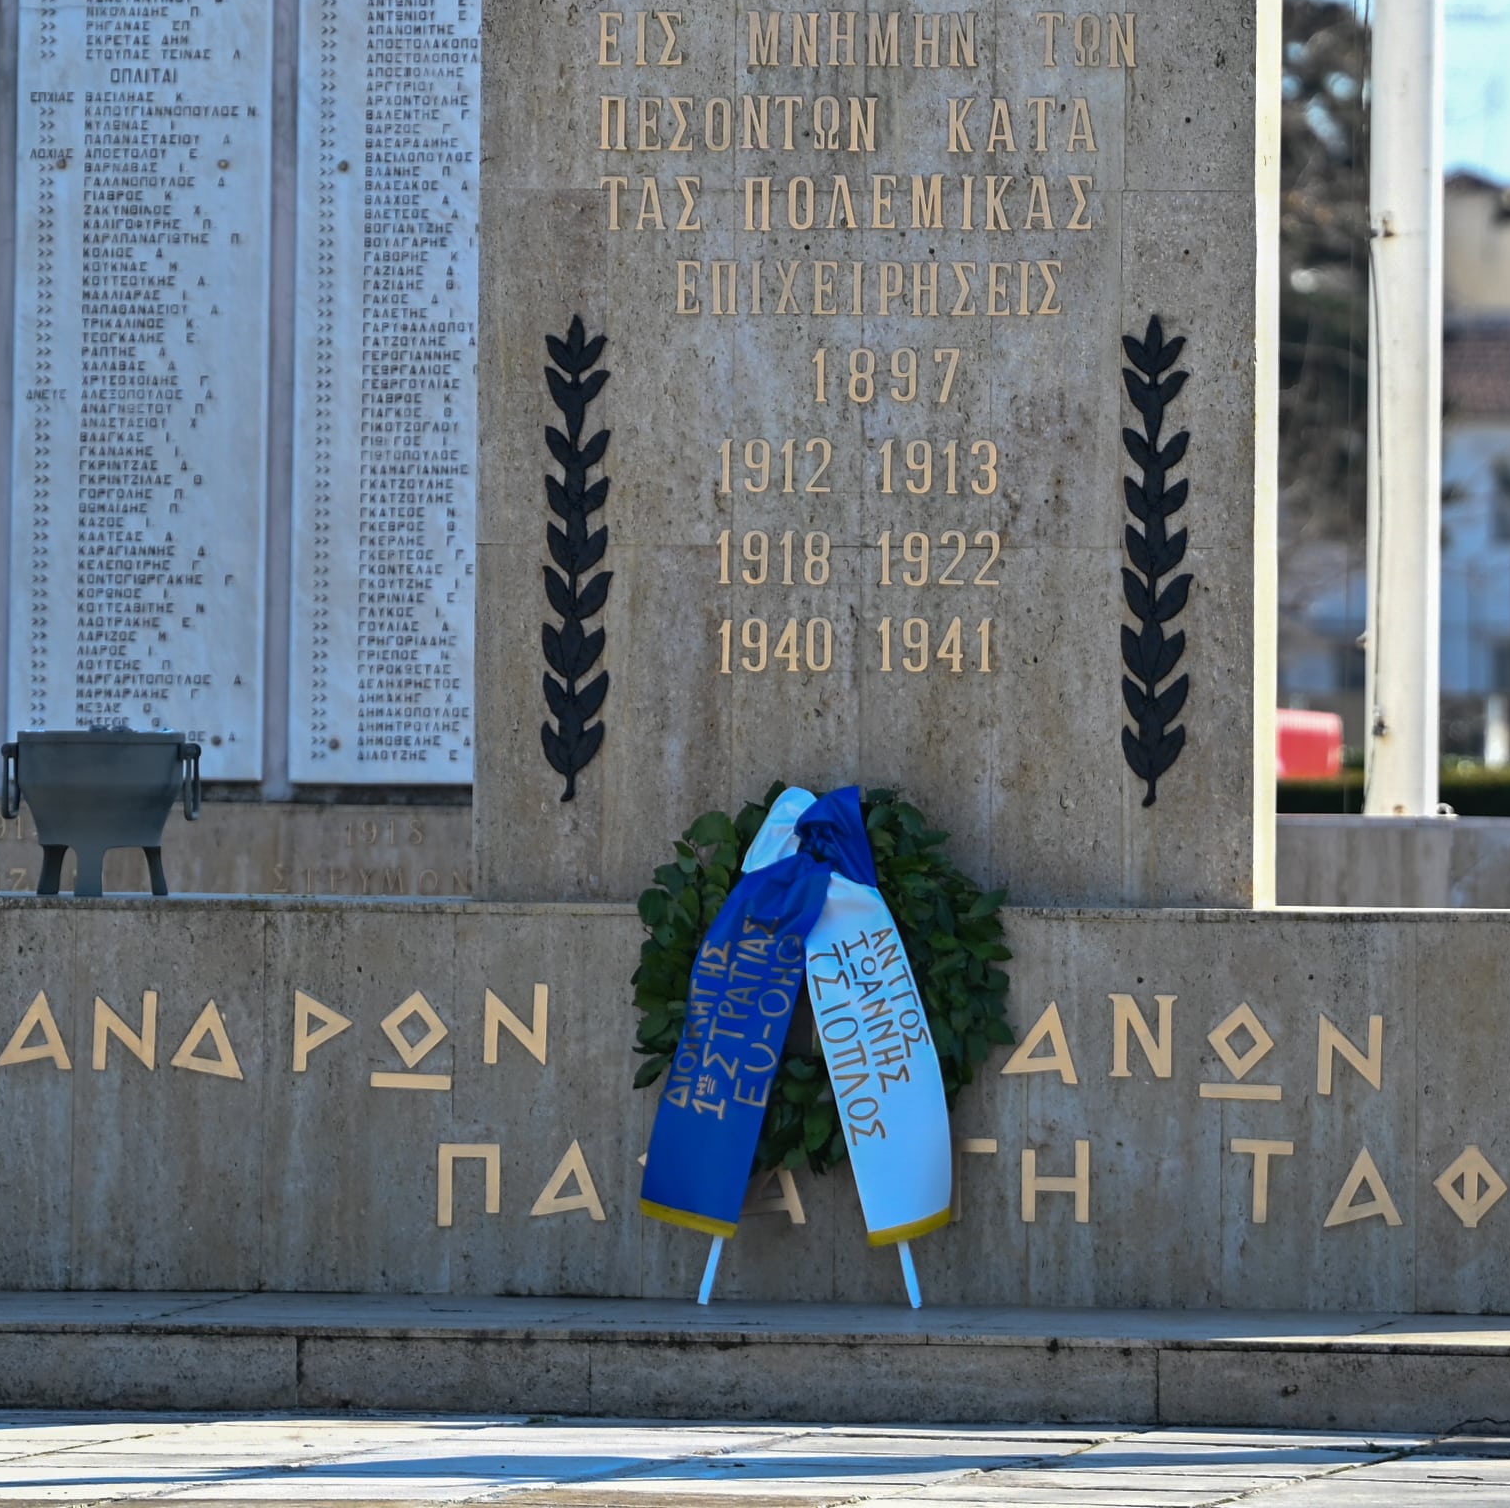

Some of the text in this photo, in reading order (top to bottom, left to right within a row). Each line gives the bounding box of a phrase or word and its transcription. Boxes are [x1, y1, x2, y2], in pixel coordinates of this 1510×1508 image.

[597, 10, 1139, 69] ΕΙΣ ΜΝΗΜΗΝ ΤΩΝ
[598, 95, 1098, 154] ΠΕΣΟΝΤΩΝ ΚΑΤΑ
[599, 173, 1095, 231] ΤΑΣ ΠΟΛΕΜΙΚΑΣ
[674, 258, 1065, 317] ΕΠΙΧΕΙΡΗΣΕΙΣ
[811, 346, 962, 404] 1897
[717, 436, 1000, 495] 1912 1913
[716, 529, 1002, 587] 1918 1922
[717, 616, 995, 675] 1940 1941
[702, 914, 780, 1080] ΣΤΡΑΤΙΑΣ
[841, 930, 911, 1094] ΙΩΑΝΝΗΣ
[871, 926, 931, 1059] ΑΝΤΓΟΣ
[664, 940, 731, 1110] ΔΙΟΙΚΗΤΗΣ
[808, 942, 888, 1148] ΤΣΙΟΠΛΟΣ
[1000, 993, 1383, 1101] ΑΝΩΝ
[436, 1138, 807, 1227] ΠΑΑ
